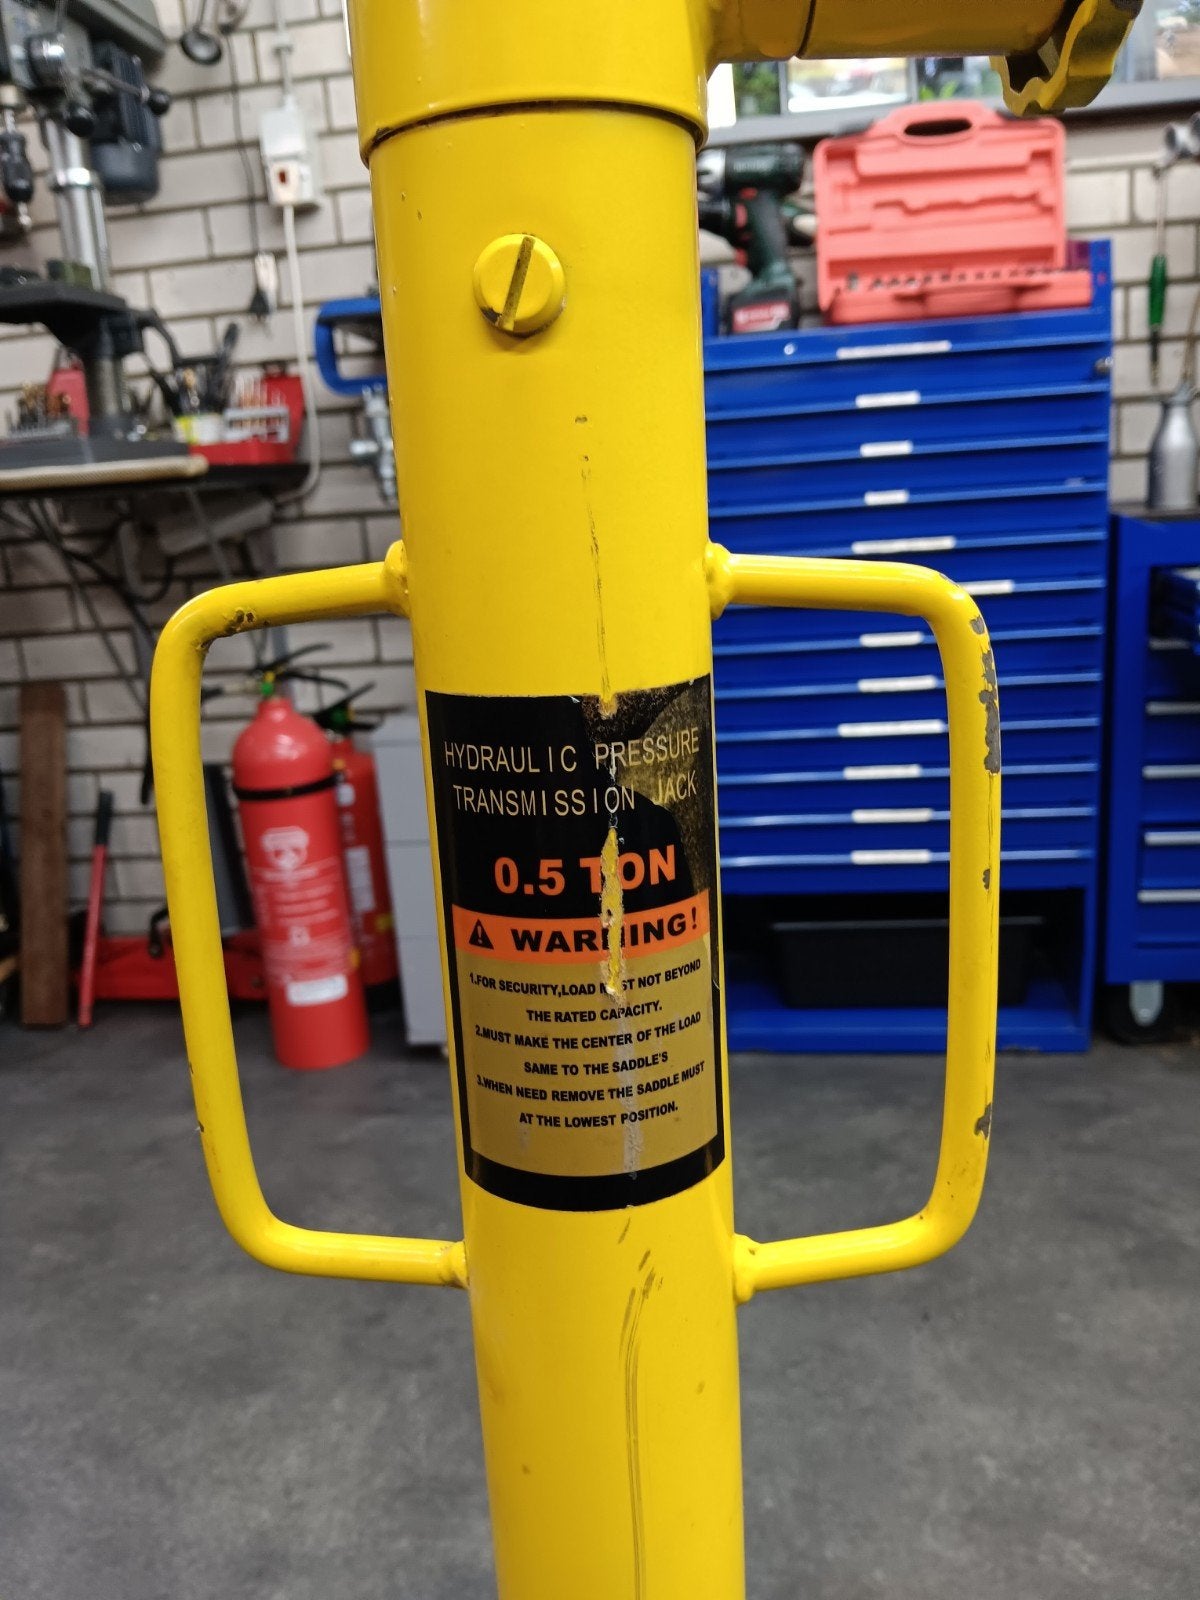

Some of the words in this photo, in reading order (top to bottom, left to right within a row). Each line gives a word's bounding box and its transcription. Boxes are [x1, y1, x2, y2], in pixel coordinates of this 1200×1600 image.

[444, 741, 577, 773] HYDRAULIC
[595, 727, 700, 770] PRESSURE
[453, 784, 634, 817] TRANSMISSION
[652, 770, 697, 806] JACK
[494, 857, 566, 896] 0.5
[579, 844, 676, 894] TON
[600, 979, 635, 994] MST
[638, 973, 661, 988] NOT
[665, 959, 701, 981] BEYOND
[514, 1034, 549, 1049] MAKE
[553, 1037, 578, 1050] THE
[582, 1033, 632, 1050] CENTER
[636, 1028, 651, 1042] OF
[654, 1022, 676, 1038] THE
[678, 1011, 701, 1031] LOAD
[526, 1009, 551, 1022] THE
[554, 1010, 596, 1023] RATED
[600, 1000, 662, 1021] CAPACITY.
[516, 1085, 547, 1100] NEED
[551, 1090, 605, 1102] REMOVE
[608, 1086, 633, 1100] THE
[637, 1073, 679, 1096] SADDLE
[681, 1061, 705, 1082] MUST
[524, 1061, 558, 1075] SAME
[562, 1064, 579, 1076] TO
[583, 1063, 609, 1076] THE
[612, 1051, 668, 1073] SADDLE'S
[519, 1112, 533, 1125] AT
[536, 1115, 560, 1127] THE
[564, 1115, 616, 1128] LOWEST
[621, 1101, 678, 1124] POSITION.
